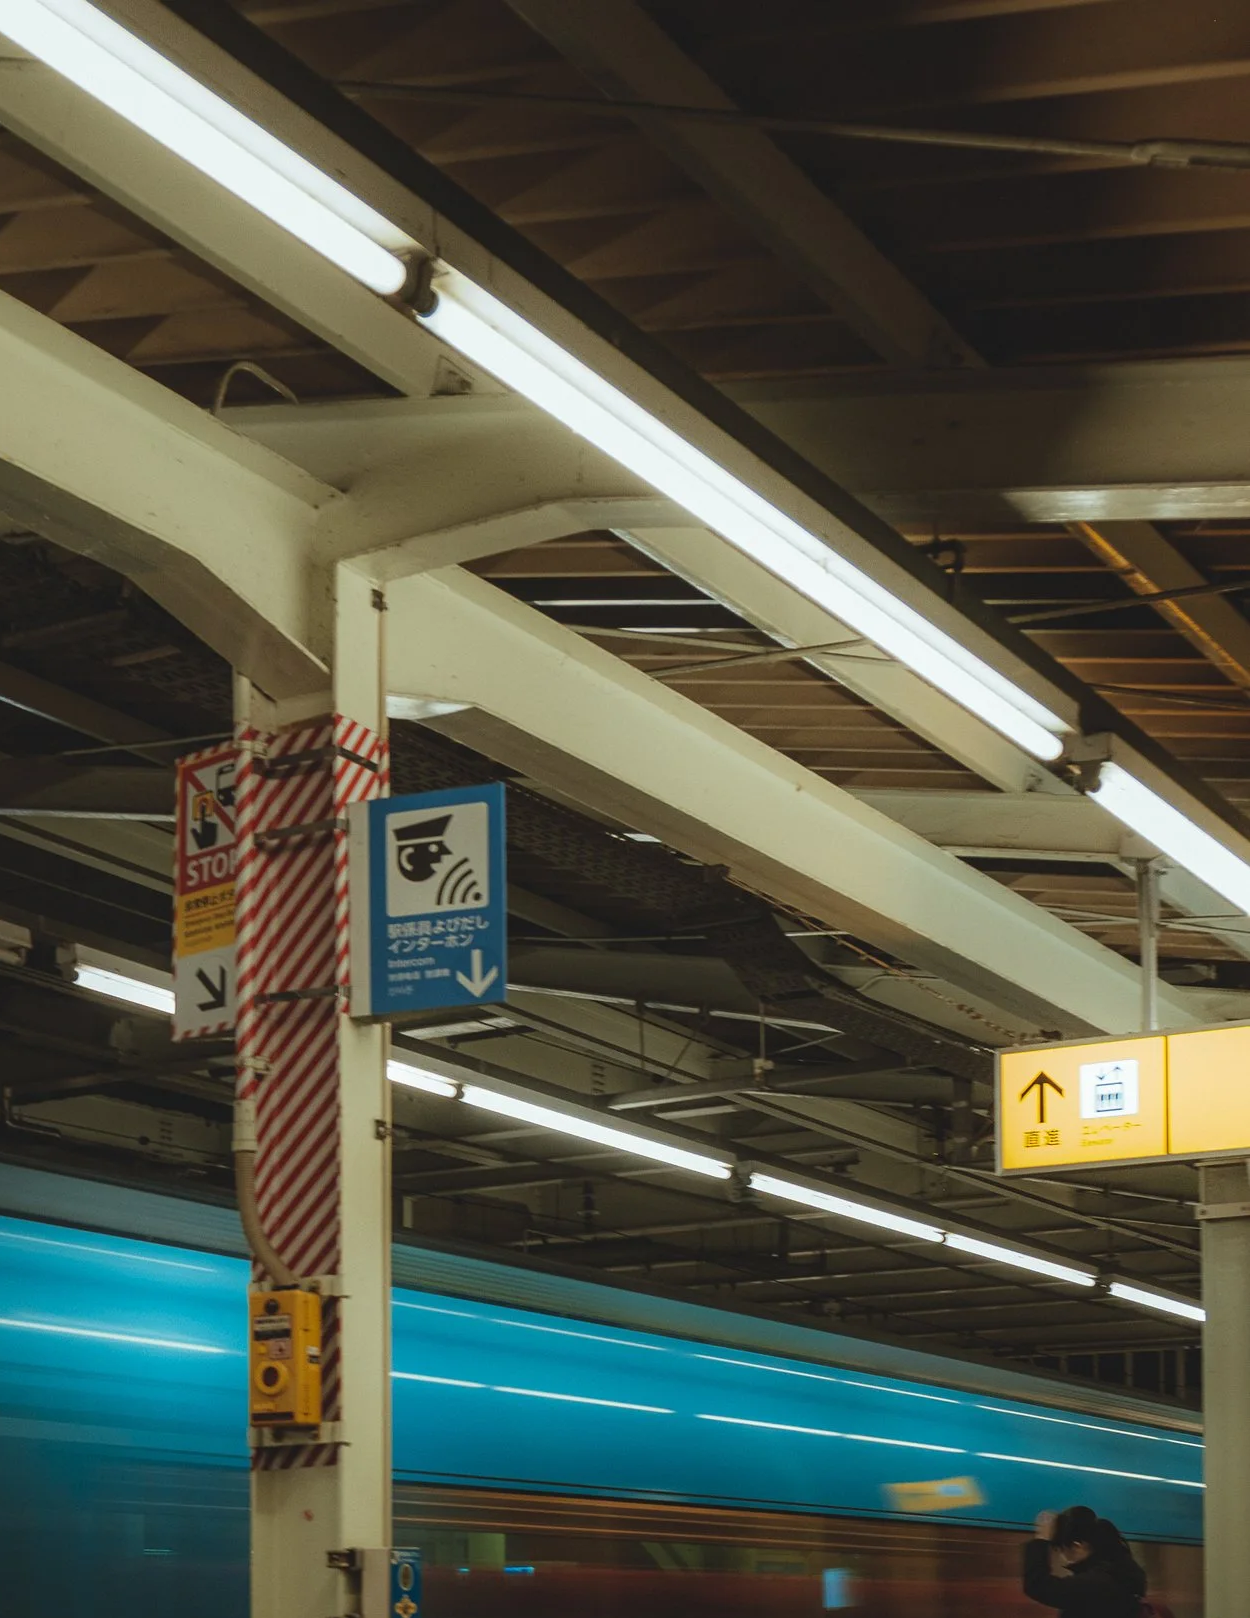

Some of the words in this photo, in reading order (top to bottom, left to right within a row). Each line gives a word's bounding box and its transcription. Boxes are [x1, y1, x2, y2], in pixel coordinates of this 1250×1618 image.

[387, 915, 489, 939] 駅係員よびだし
[387, 934, 474, 954] インターホン
[1023, 1129, 1061, 1148] 直進
